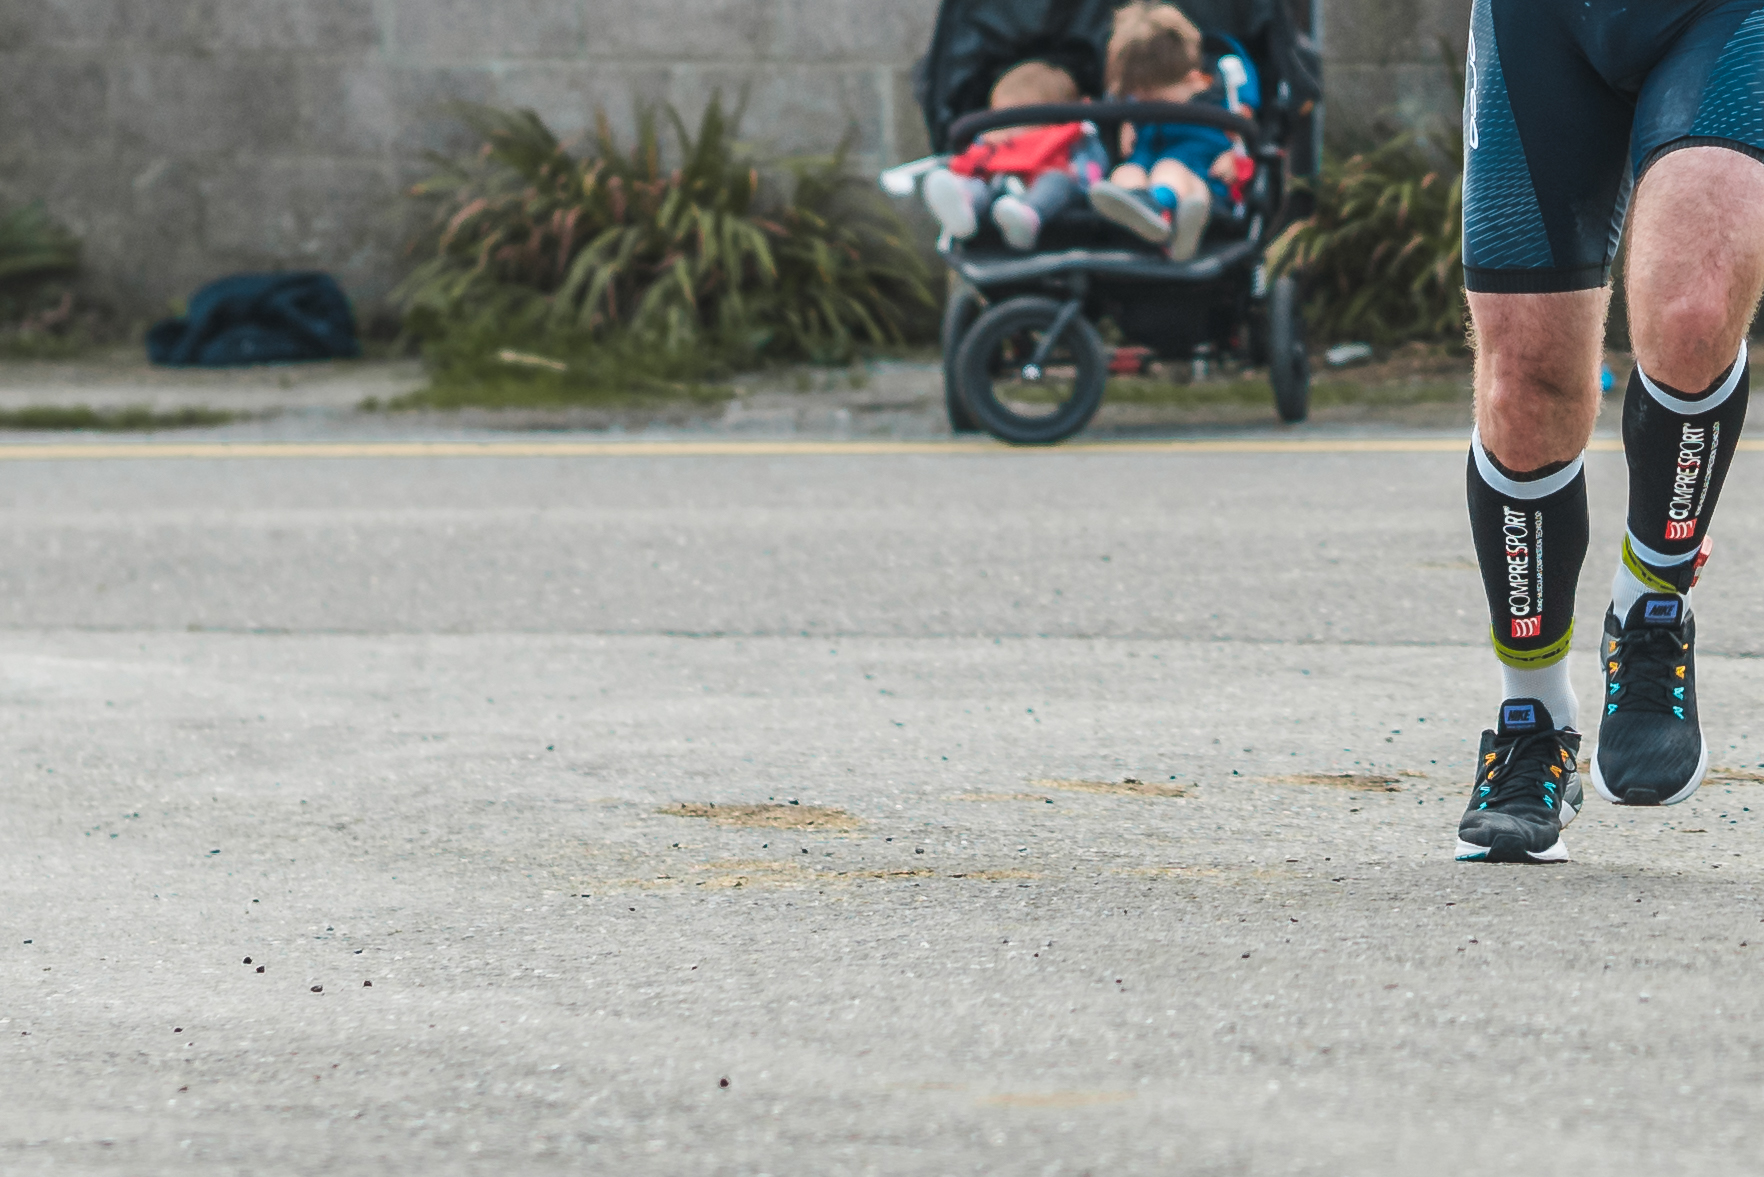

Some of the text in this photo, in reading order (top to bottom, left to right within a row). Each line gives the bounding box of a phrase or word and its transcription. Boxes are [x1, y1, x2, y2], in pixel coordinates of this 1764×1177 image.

[1469, 28, 1479, 150] orca
[1648, 604, 1676, 617] NIKE
[1507, 709, 1532, 722] NIKE
